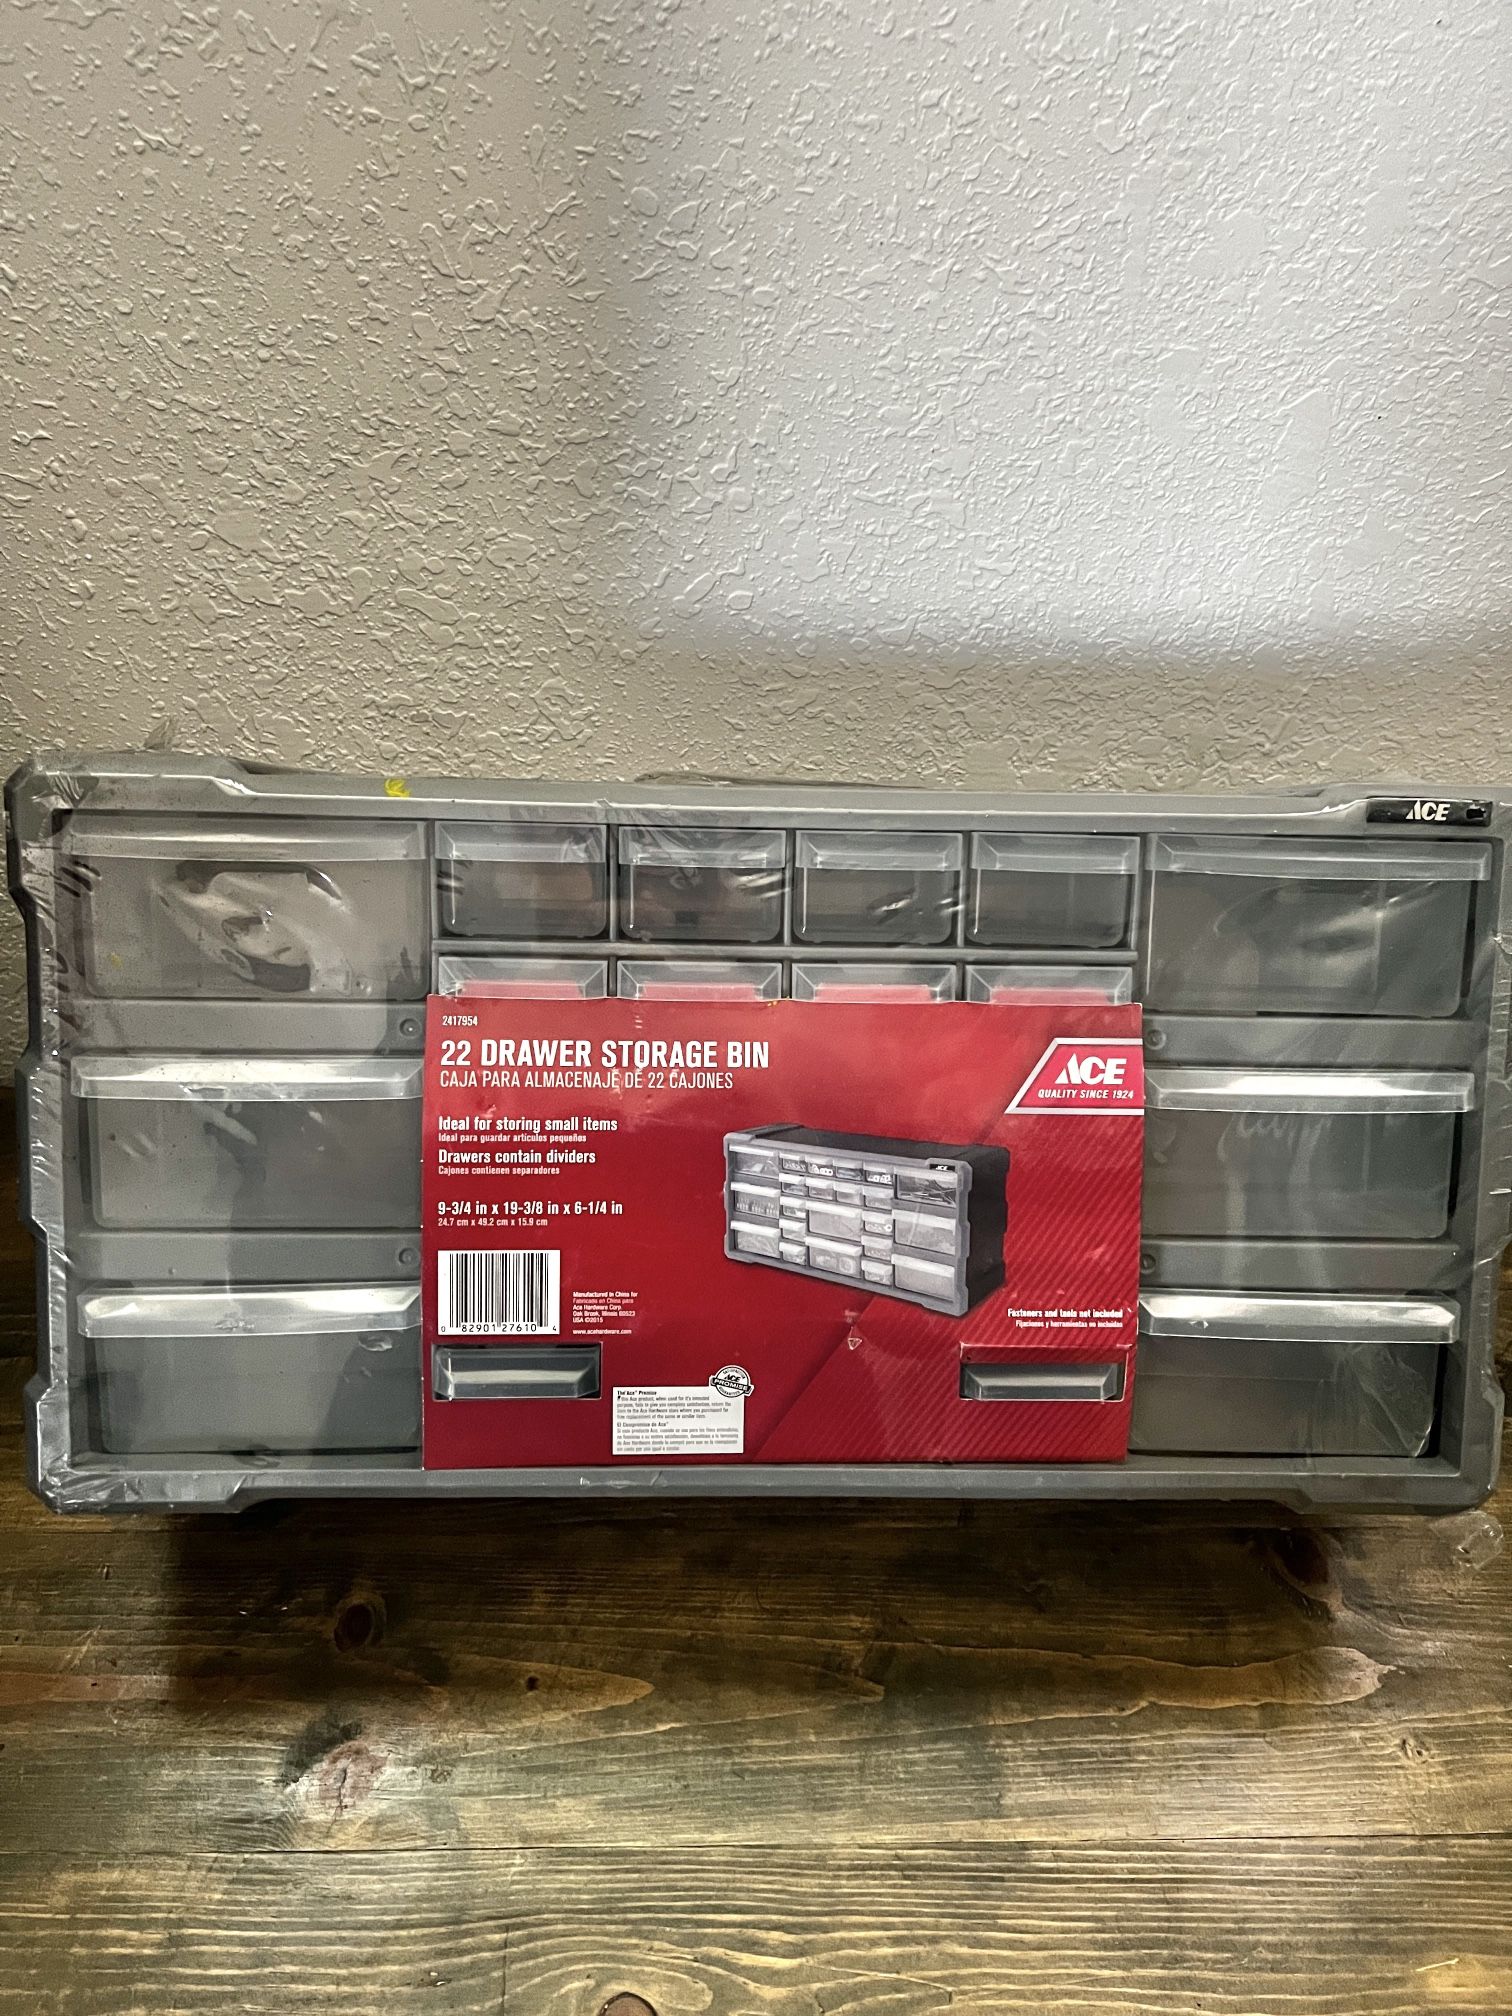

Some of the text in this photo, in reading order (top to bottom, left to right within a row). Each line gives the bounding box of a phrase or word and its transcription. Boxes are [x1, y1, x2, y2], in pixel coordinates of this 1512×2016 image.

[1405, 801, 1450, 820] ACE
[442, 1015, 477, 1026] 2417954
[440, 1040, 769, 1068] 22 DRAWER STORAGE BIN
[1054, 1052, 1127, 1085] ACE
[440, 1071, 733, 1088] CAJA PARA ALMACENAJE DE 22 CAJONES
[1038, 1089, 1133, 1099] QUALITY SINCE 1924
[438, 1117, 617, 1133] Ideal for storing small items
[438, 1133, 458, 1142] Ideal
[461, 1134, 477, 1143] para
[480, 1133, 511, 1143] guardar
[550, 1133, 587, 1143] pequeños
[438, 1149, 596, 1163] Drawers contain dividers
[438, 1166, 560, 1175] Cajones contienen separadores
[438, 1201, 623, 1215] 9-3/4 in x 19-3/8 in x 6-1/4 in
[438, 1218, 454, 1226] 24.7
[478, 1218, 494, 1226] 49.2
[518, 1218, 533, 1226] 15.9
[1008, 1308, 1042, 1317] Fasteners
[1045, 1308, 1057, 1317] and
[1079, 1308, 1091, 1317] not
[1093, 1308, 1123, 1317] included
[461, 1324, 496, 1332] 82901
[502, 1324, 537, 1332] 27610
[714, 1378, 748, 1391] PROMISE
